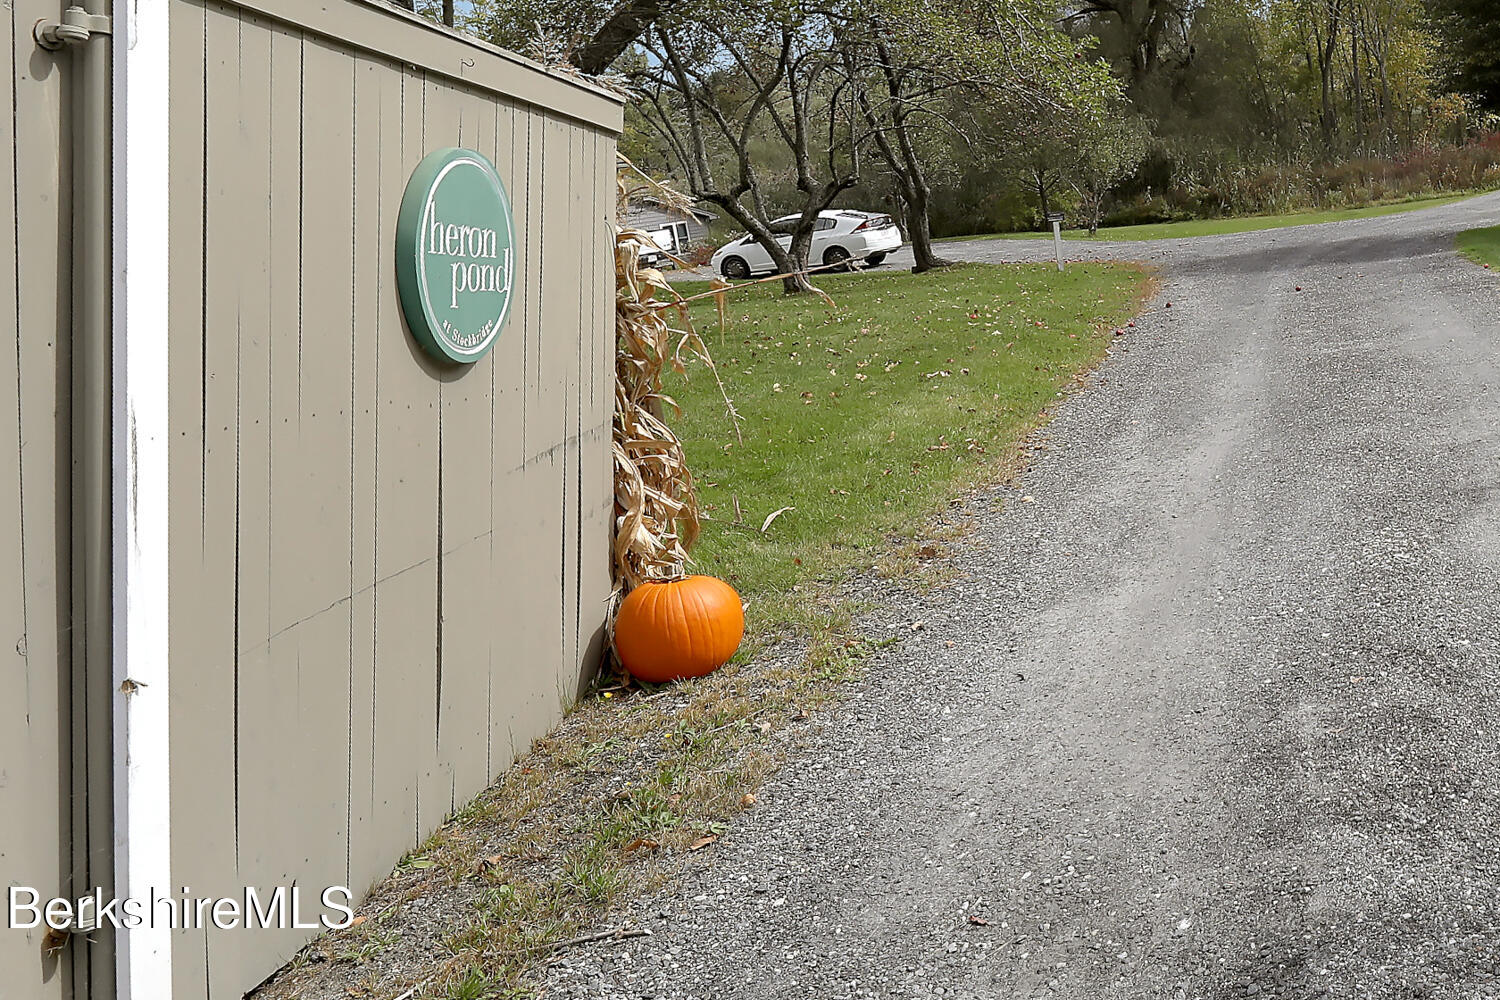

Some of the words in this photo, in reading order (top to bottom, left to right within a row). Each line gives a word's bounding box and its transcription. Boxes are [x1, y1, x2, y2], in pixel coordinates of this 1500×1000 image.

[428, 201, 498, 258] heron
[450, 248, 511, 309] pond
[442, 319, 452, 334] at
[452, 319, 493, 347] Stockbridge
